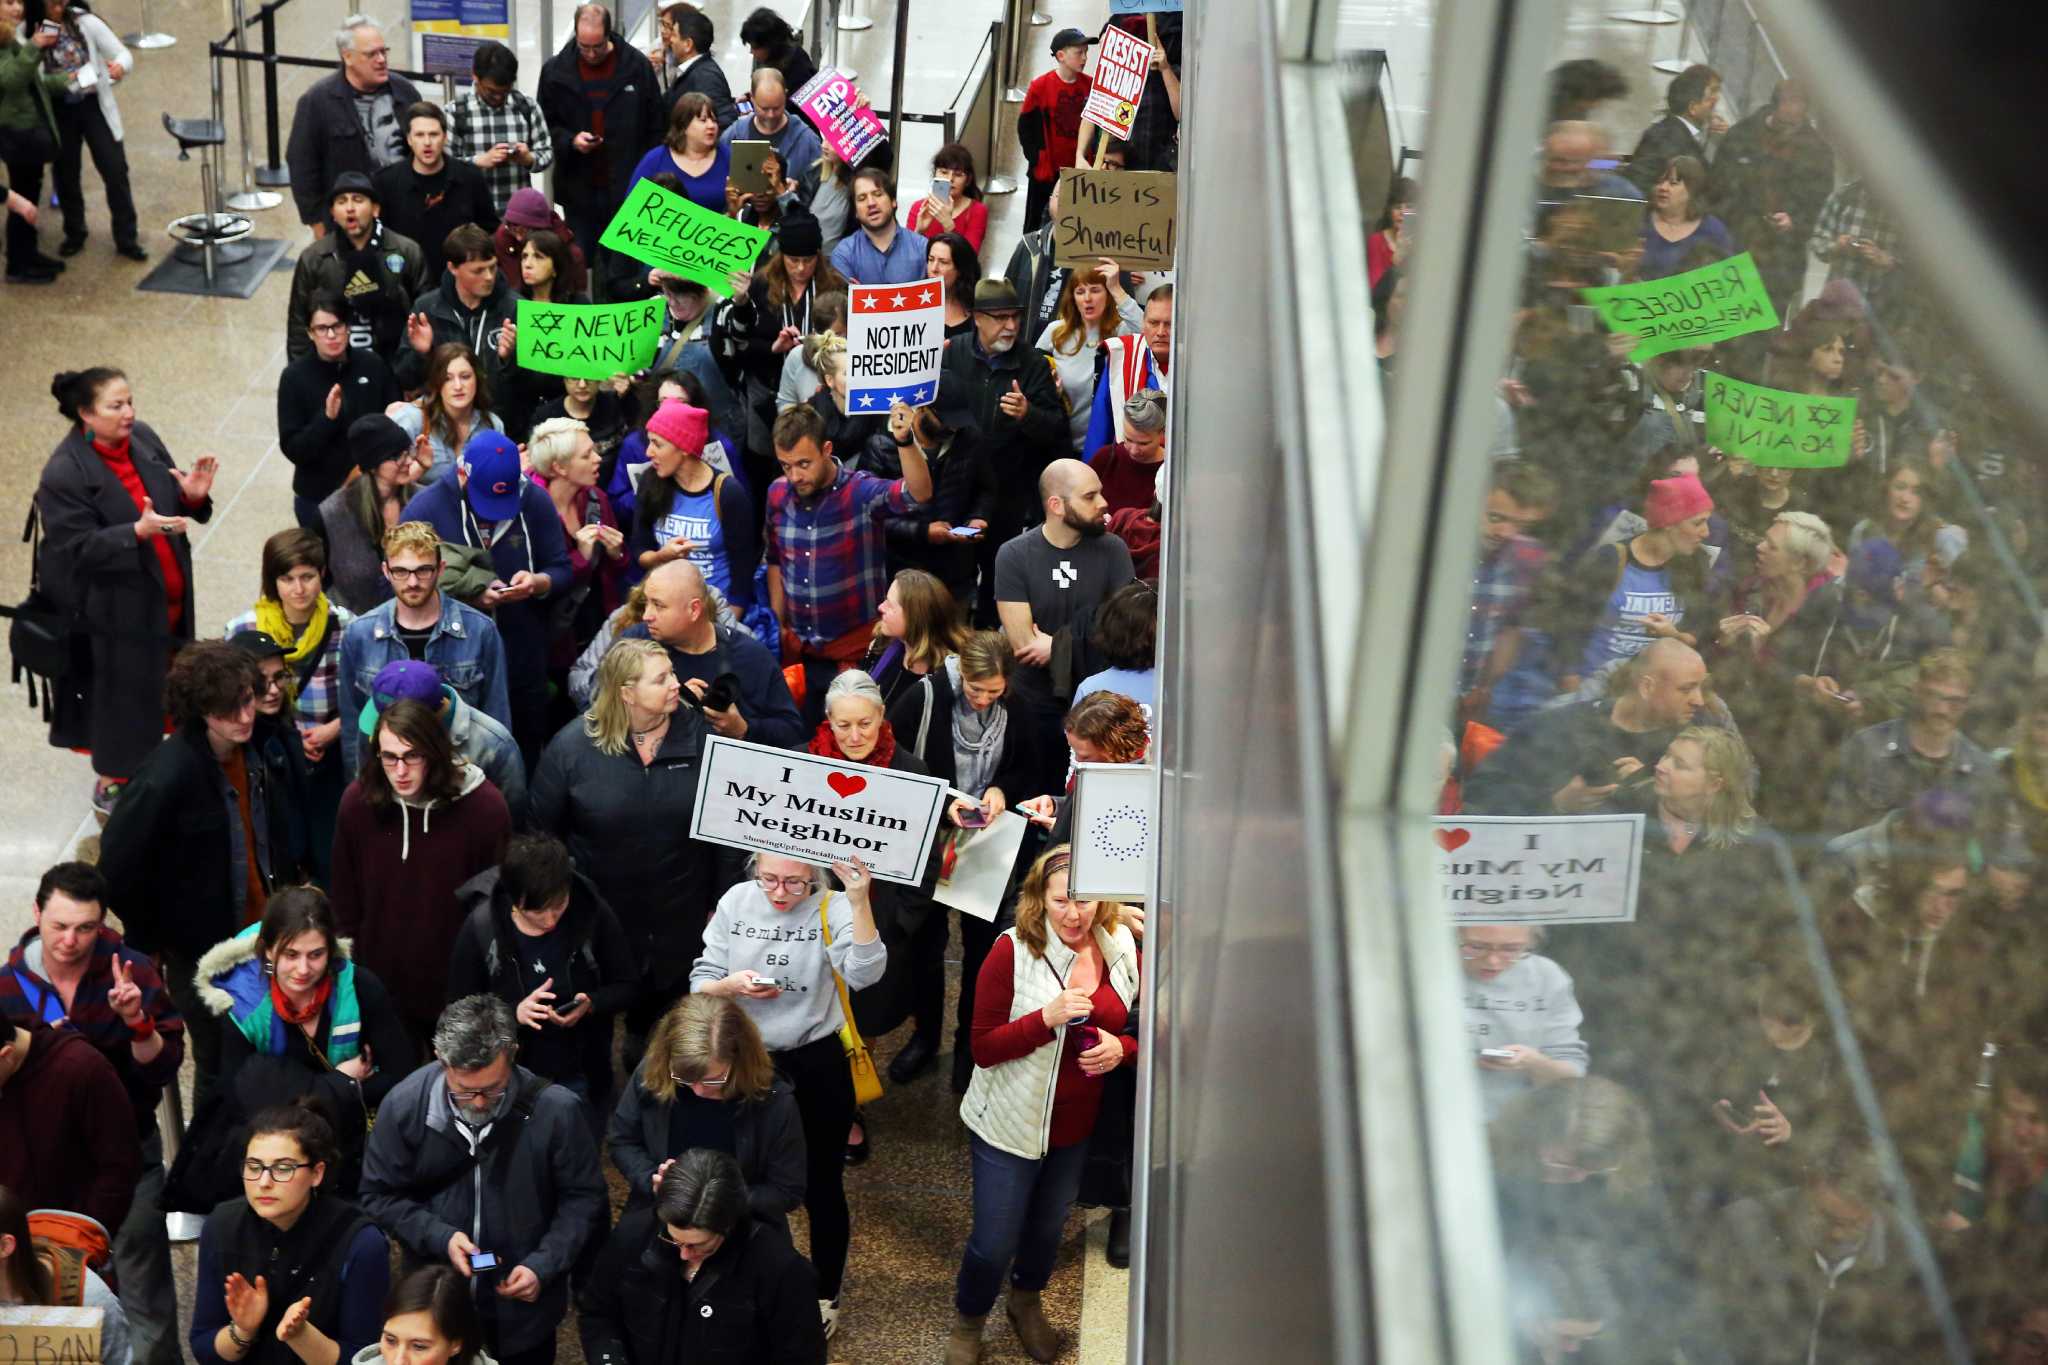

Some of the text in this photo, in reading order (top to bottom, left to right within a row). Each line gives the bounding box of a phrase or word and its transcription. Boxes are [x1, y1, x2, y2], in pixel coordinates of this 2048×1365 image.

[1103, 30, 1149, 75] RESIST
[811, 81, 848, 118] END
[1097, 62, 1142, 102] TRUMP
[1065, 172, 1160, 206] This is
[637, 192, 758, 261] REFUGEES
[1060, 216, 1172, 256] Shameful
[616, 222, 731, 275] WELCOME
[574, 306, 657, 338] NEVER
[867, 322, 927, 350] NOT MY
[530, 339, 636, 362] AGAIN!
[851, 347, 939, 377] PRESIDENT
[779, 766, 795, 784] I
[724, 780, 909, 832] My Muslim
[734, 807, 889, 853] Neighbor
[743, 834, 876, 870] ShowingUpForRacialJustiorg
[766, 953, 790, 966] as
[33, 1333, 94, 1365] BAN
